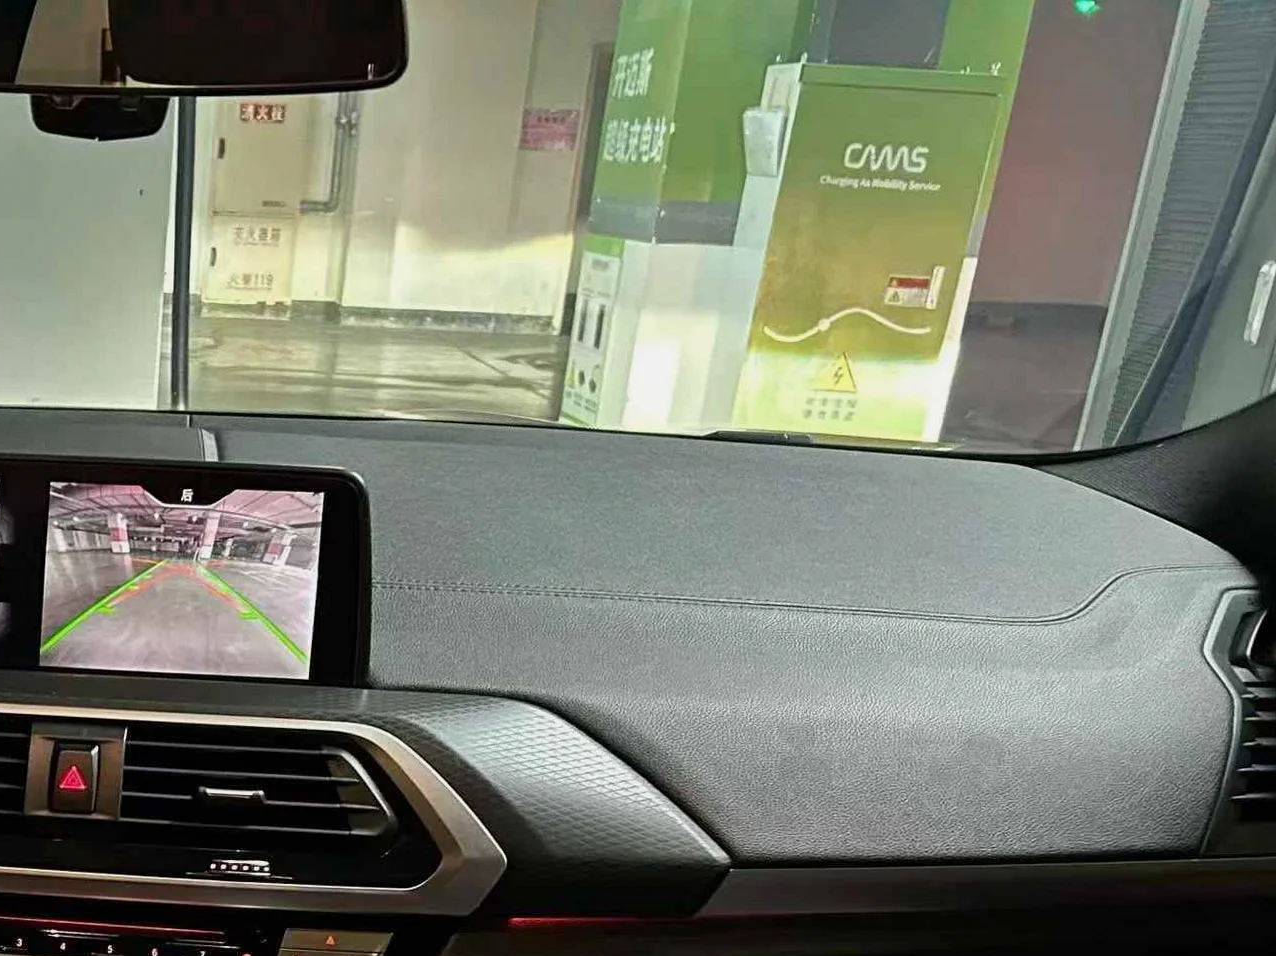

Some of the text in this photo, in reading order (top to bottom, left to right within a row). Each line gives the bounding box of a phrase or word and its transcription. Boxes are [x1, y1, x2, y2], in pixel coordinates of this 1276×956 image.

[612, 48, 654, 99] 开迈斯
[603, 116, 667, 163] 超级充电站
[819, 174, 942, 191] Charging As Mobility Service
[180, 488, 194, 502] 后
[16, 938, 23, 947] 3
[59, 942, 66, 950] 4
[107, 945, 113, 954] 5
[151, 948, 158, 956] 6
